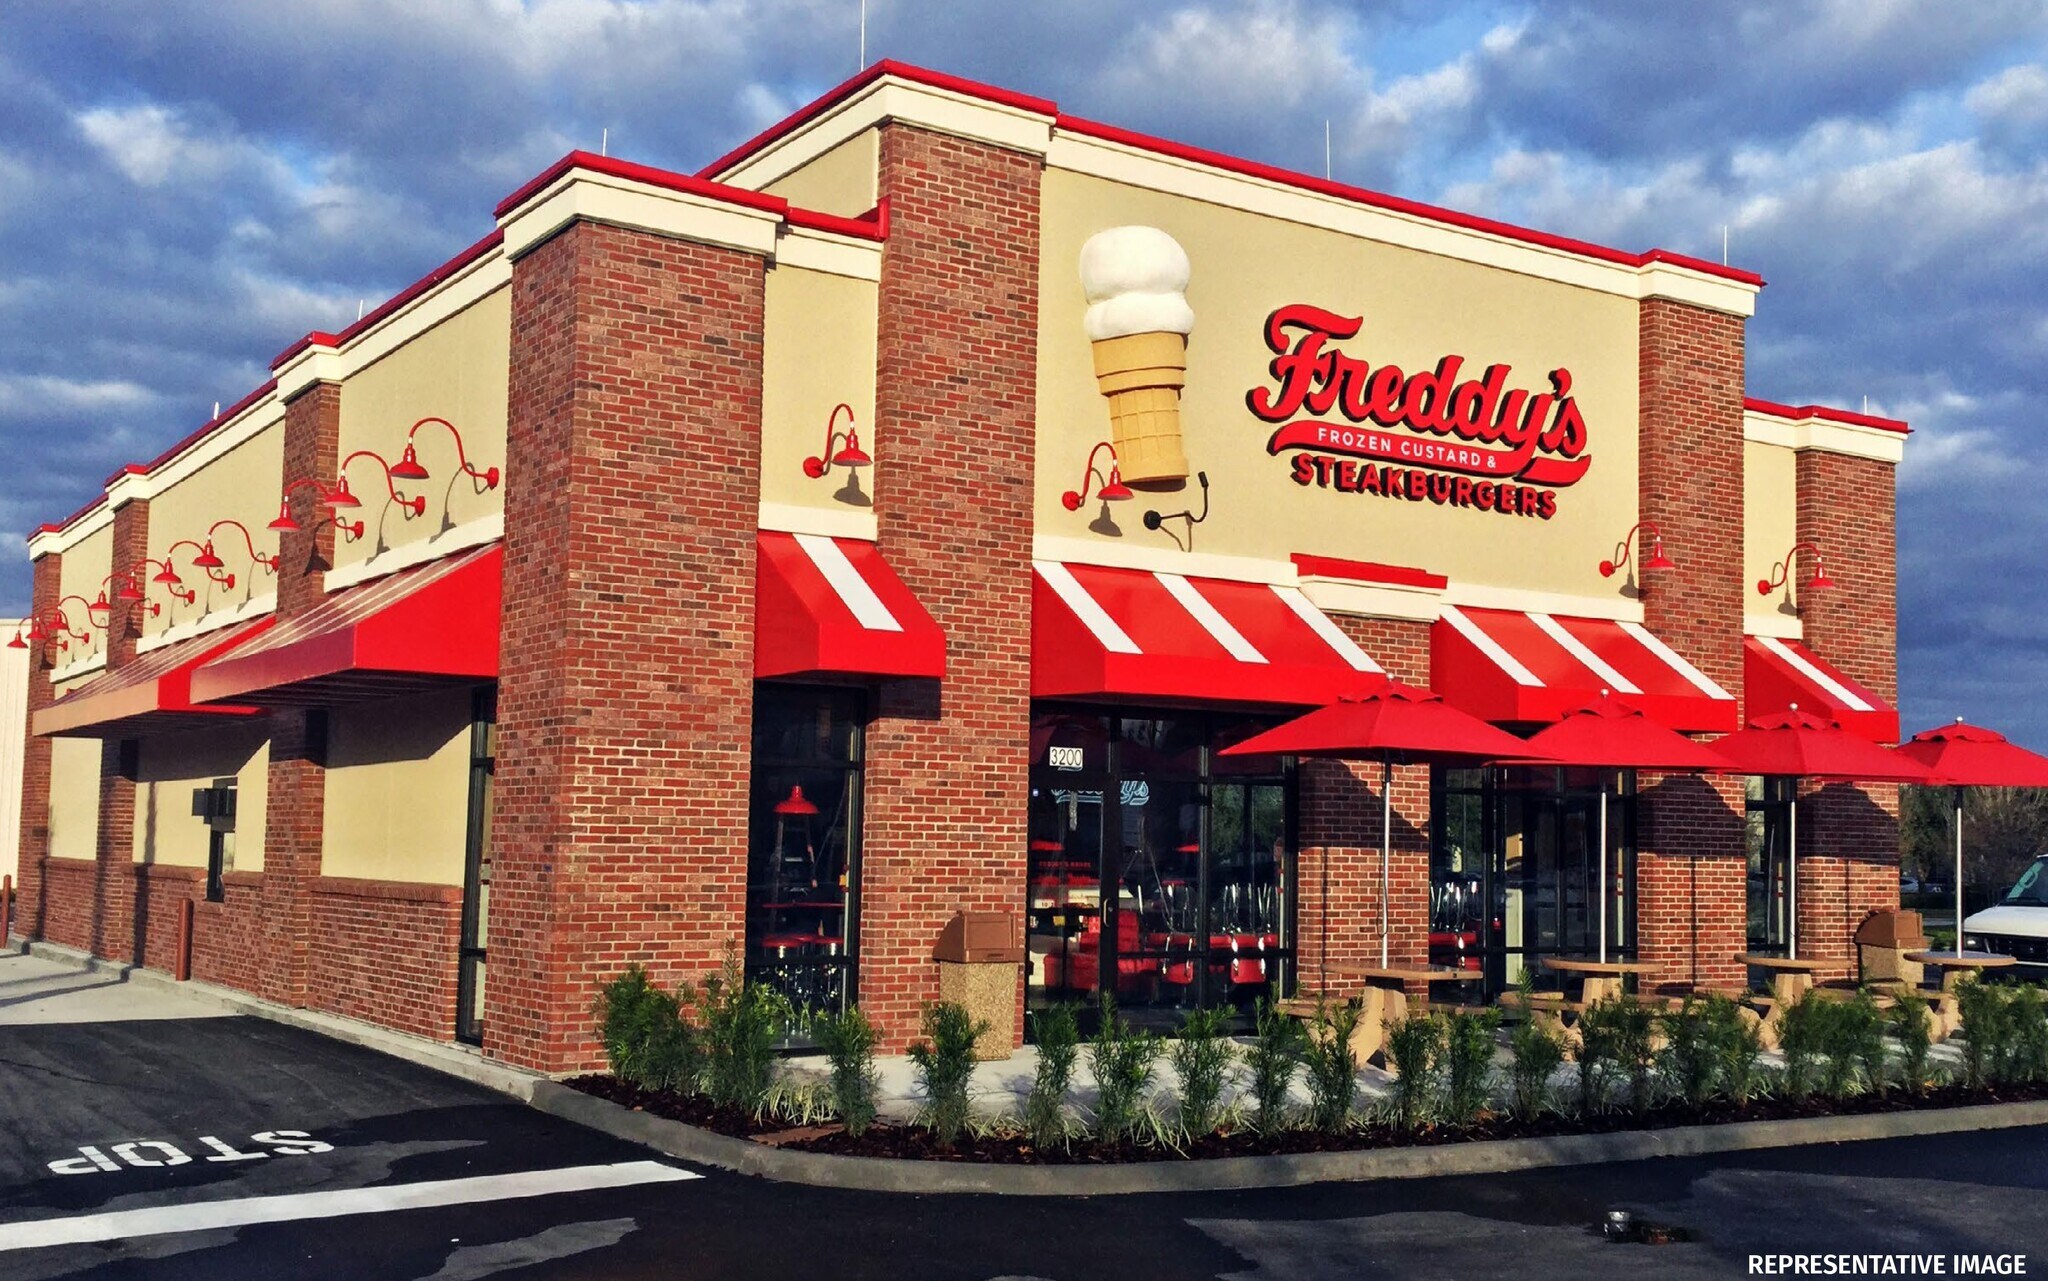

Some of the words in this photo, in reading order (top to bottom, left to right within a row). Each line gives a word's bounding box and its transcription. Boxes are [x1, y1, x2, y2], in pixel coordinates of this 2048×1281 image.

[1245, 303, 1588, 460] Freddy's
[1317, 427, 1392, 453] FROZEN
[1400, 440, 1482, 467] CUSTARD
[1486, 455, 1497, 469] &
[1291, 453, 1558, 520] STEAKBURGERS
[1051, 748, 1082, 766] 3200
[47, 1130, 335, 1174] STOP
